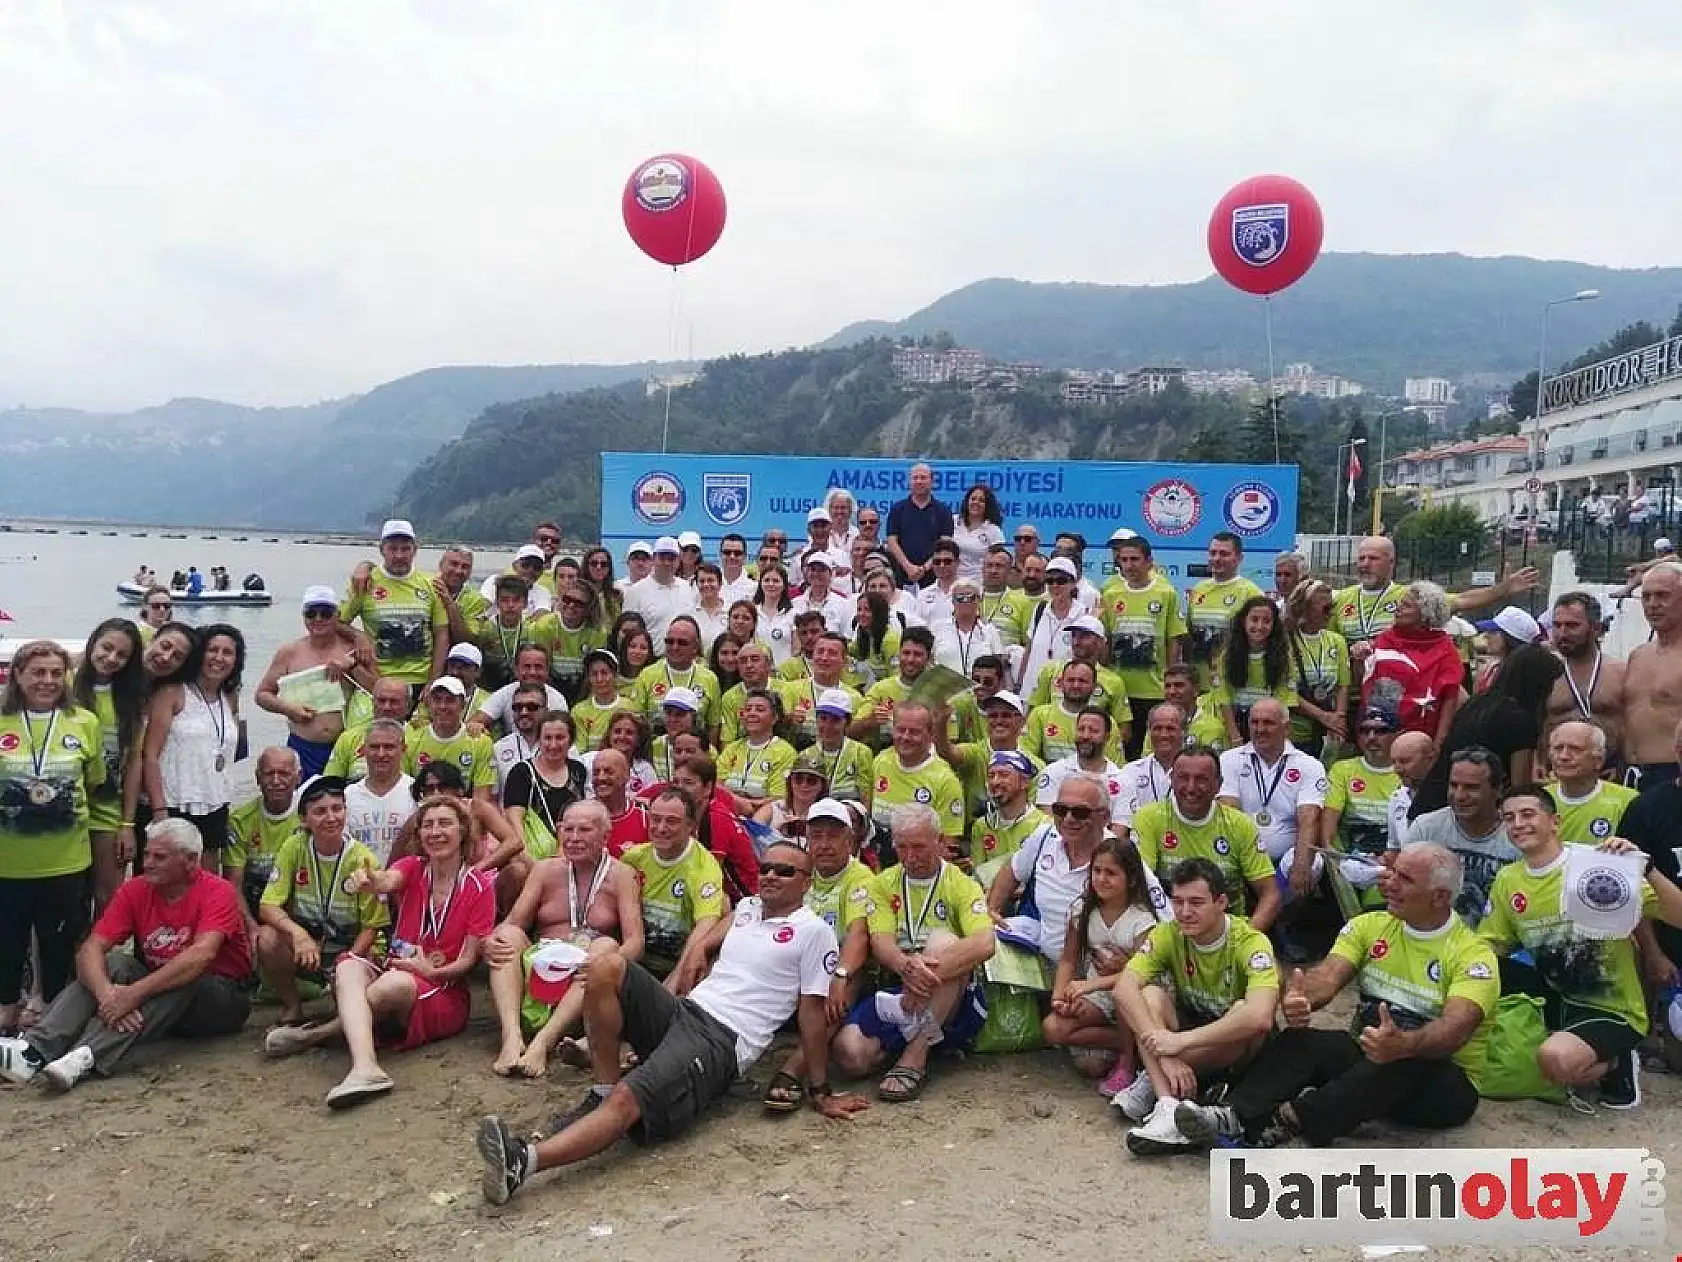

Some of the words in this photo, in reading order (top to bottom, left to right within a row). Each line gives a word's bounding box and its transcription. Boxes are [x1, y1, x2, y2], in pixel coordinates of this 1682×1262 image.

[826, 469, 912, 491] AMASR
[931, 467, 1065, 494] BELEDİYESİ
[1027, 502, 1122, 520] MARATONU
